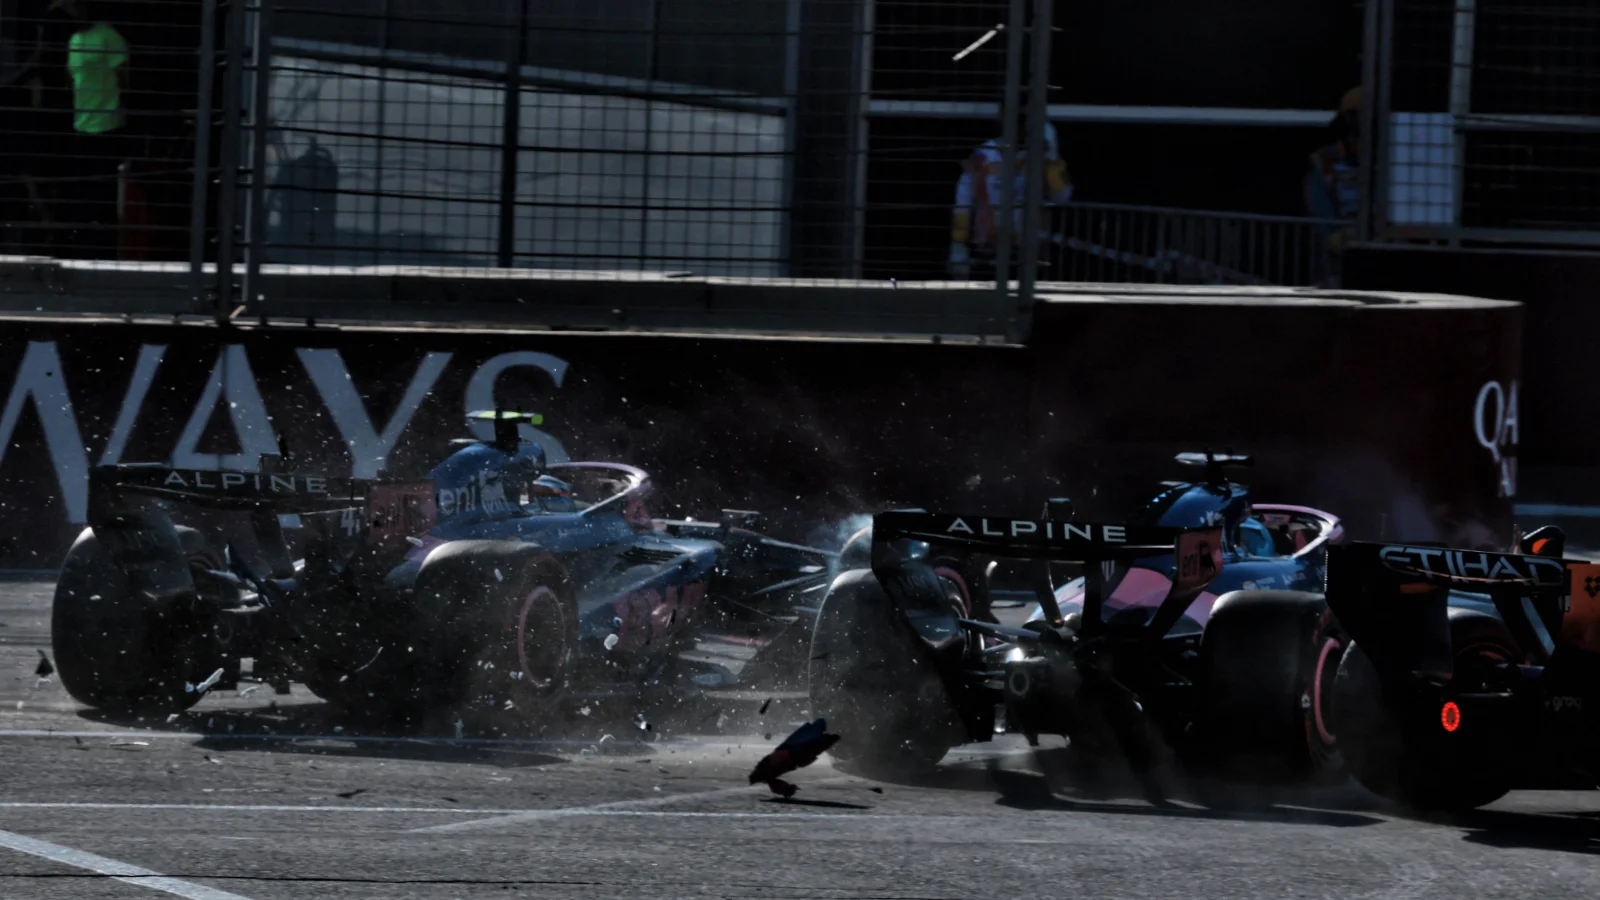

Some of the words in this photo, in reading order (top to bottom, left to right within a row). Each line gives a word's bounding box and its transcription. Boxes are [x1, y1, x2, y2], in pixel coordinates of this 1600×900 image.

[164, 470, 327, 493] ALPINE
[439, 476, 467, 516] eni
[946, 517, 1127, 543] ALPINE
[1379, 546, 1564, 587] ETIHAD
